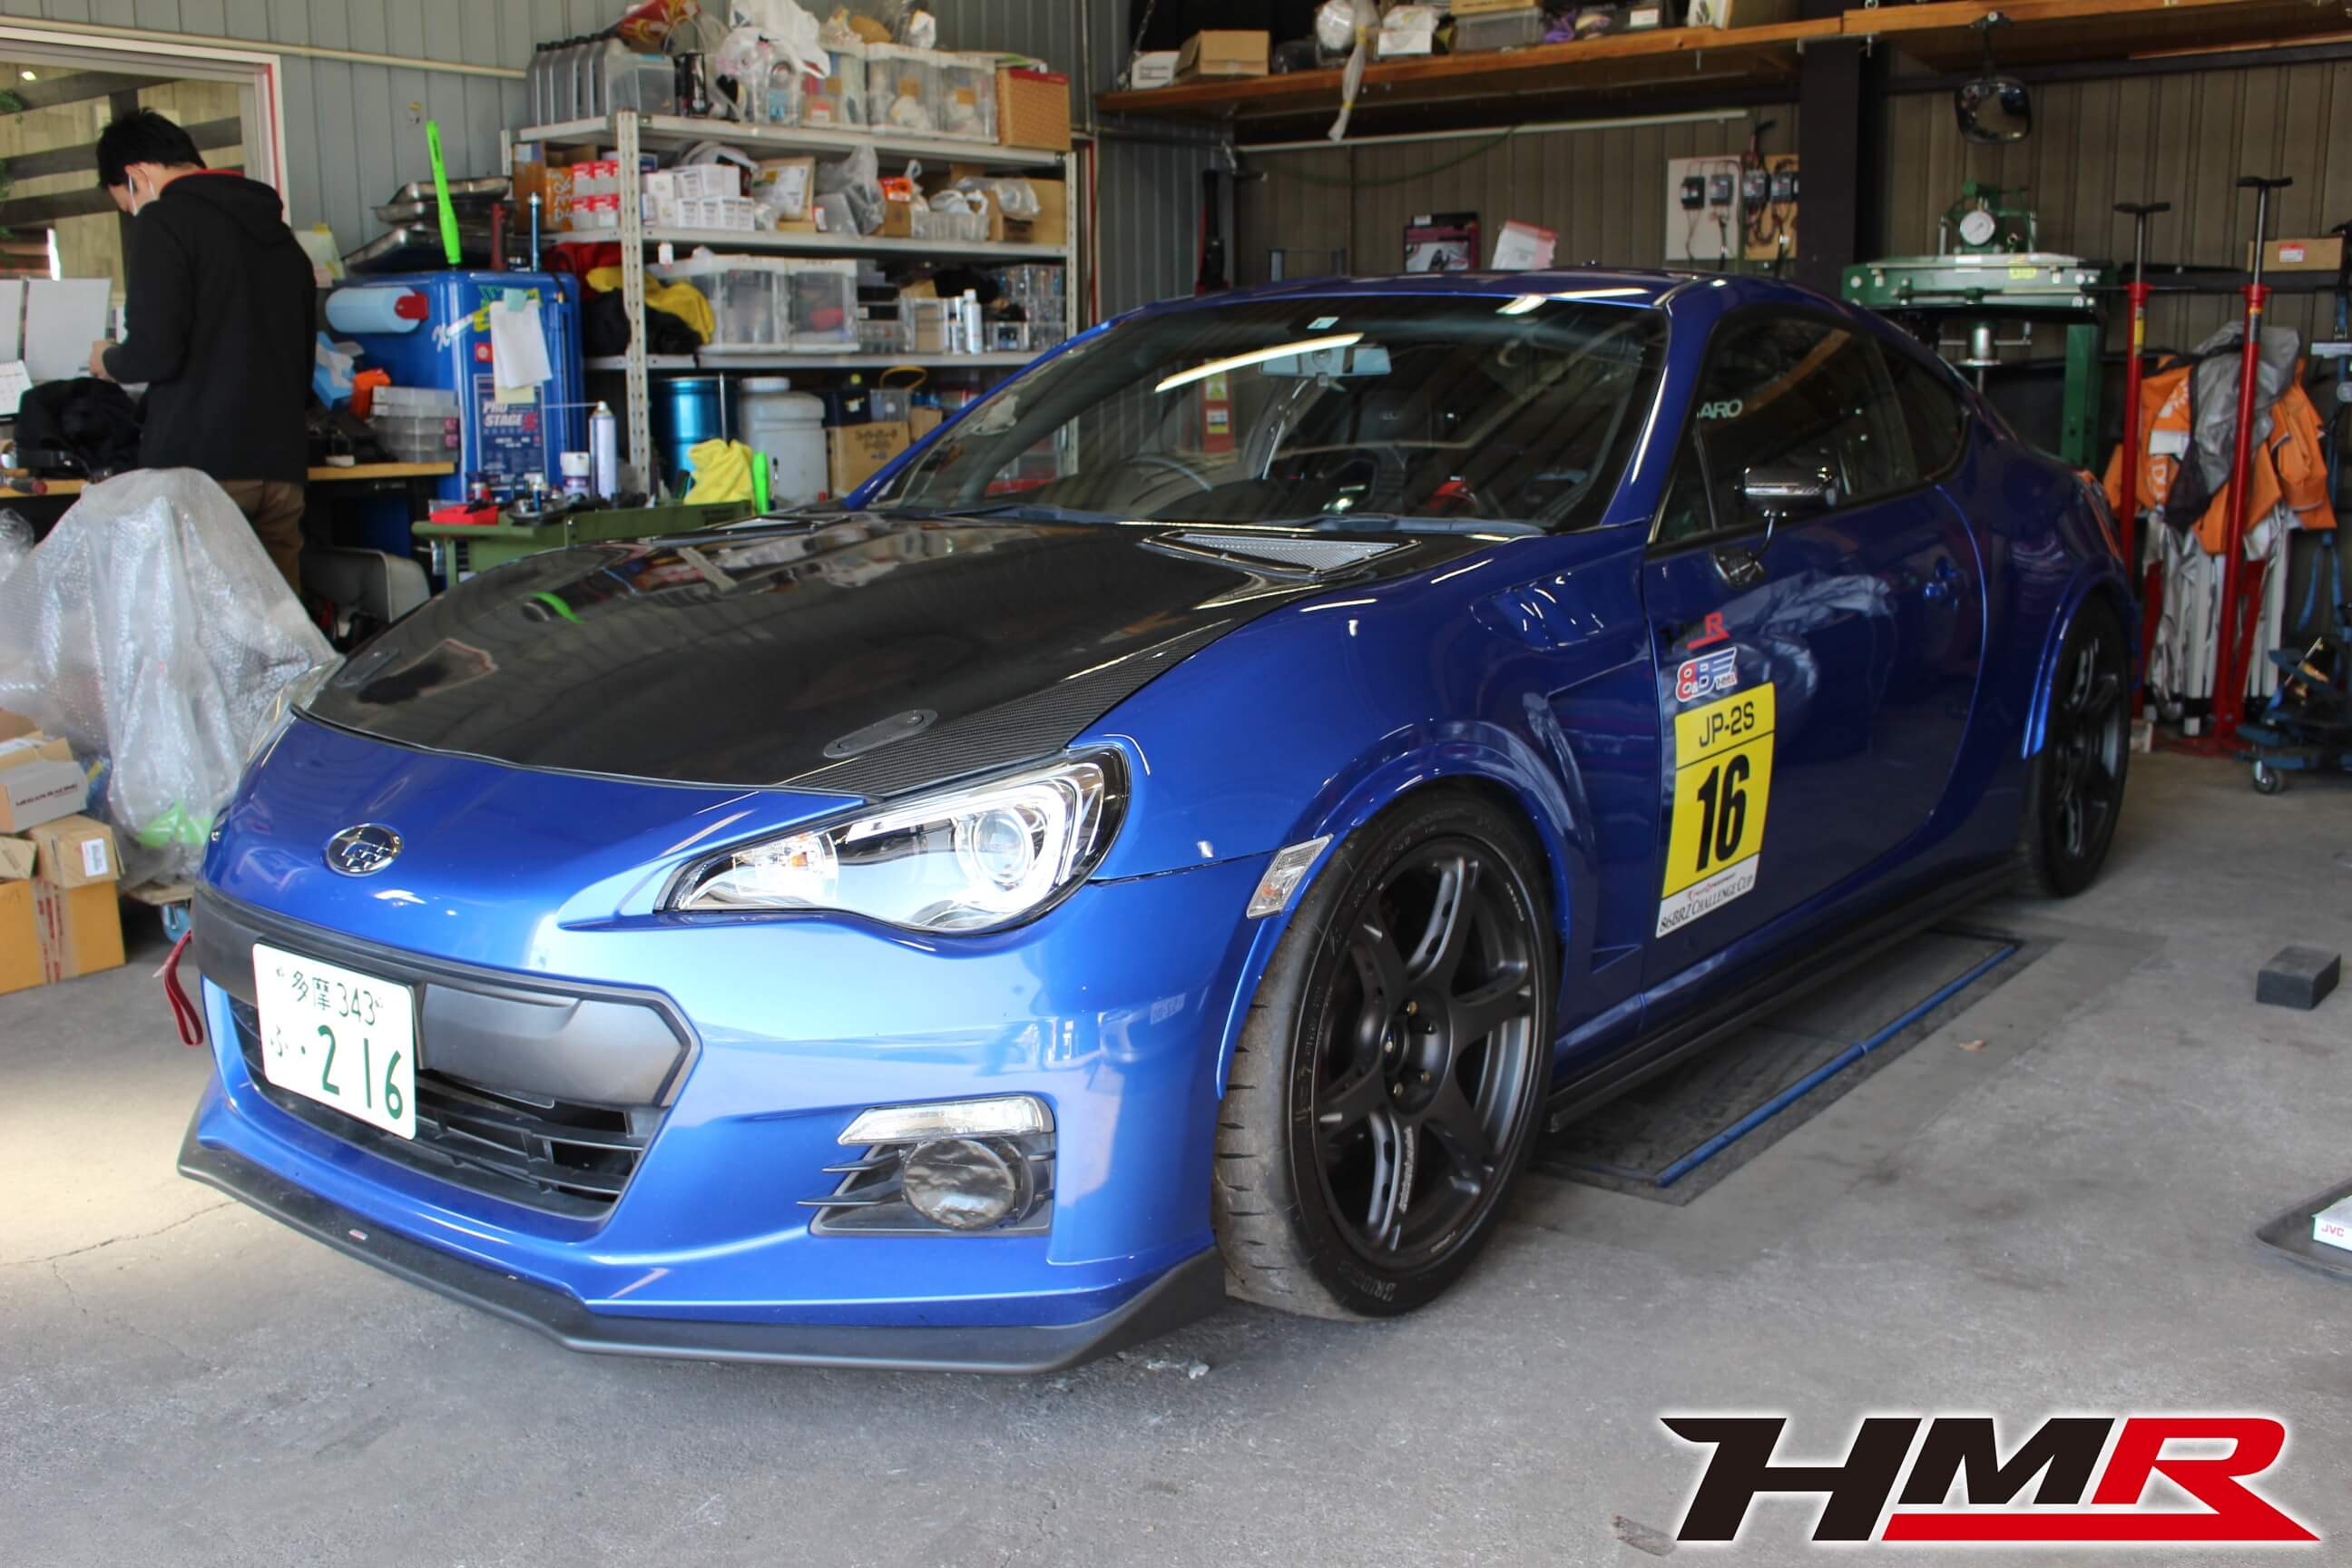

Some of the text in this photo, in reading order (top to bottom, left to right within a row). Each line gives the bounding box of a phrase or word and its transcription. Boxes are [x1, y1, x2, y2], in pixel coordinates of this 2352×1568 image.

[484, 413, 523, 427] STAGE
[1699, 702, 1755, 748] JP-2S
[1696, 754, 1750, 872] 16
[291, 970, 376, 1026] 多摩 343
[2321, 1224, 2345, 1237] JVC
